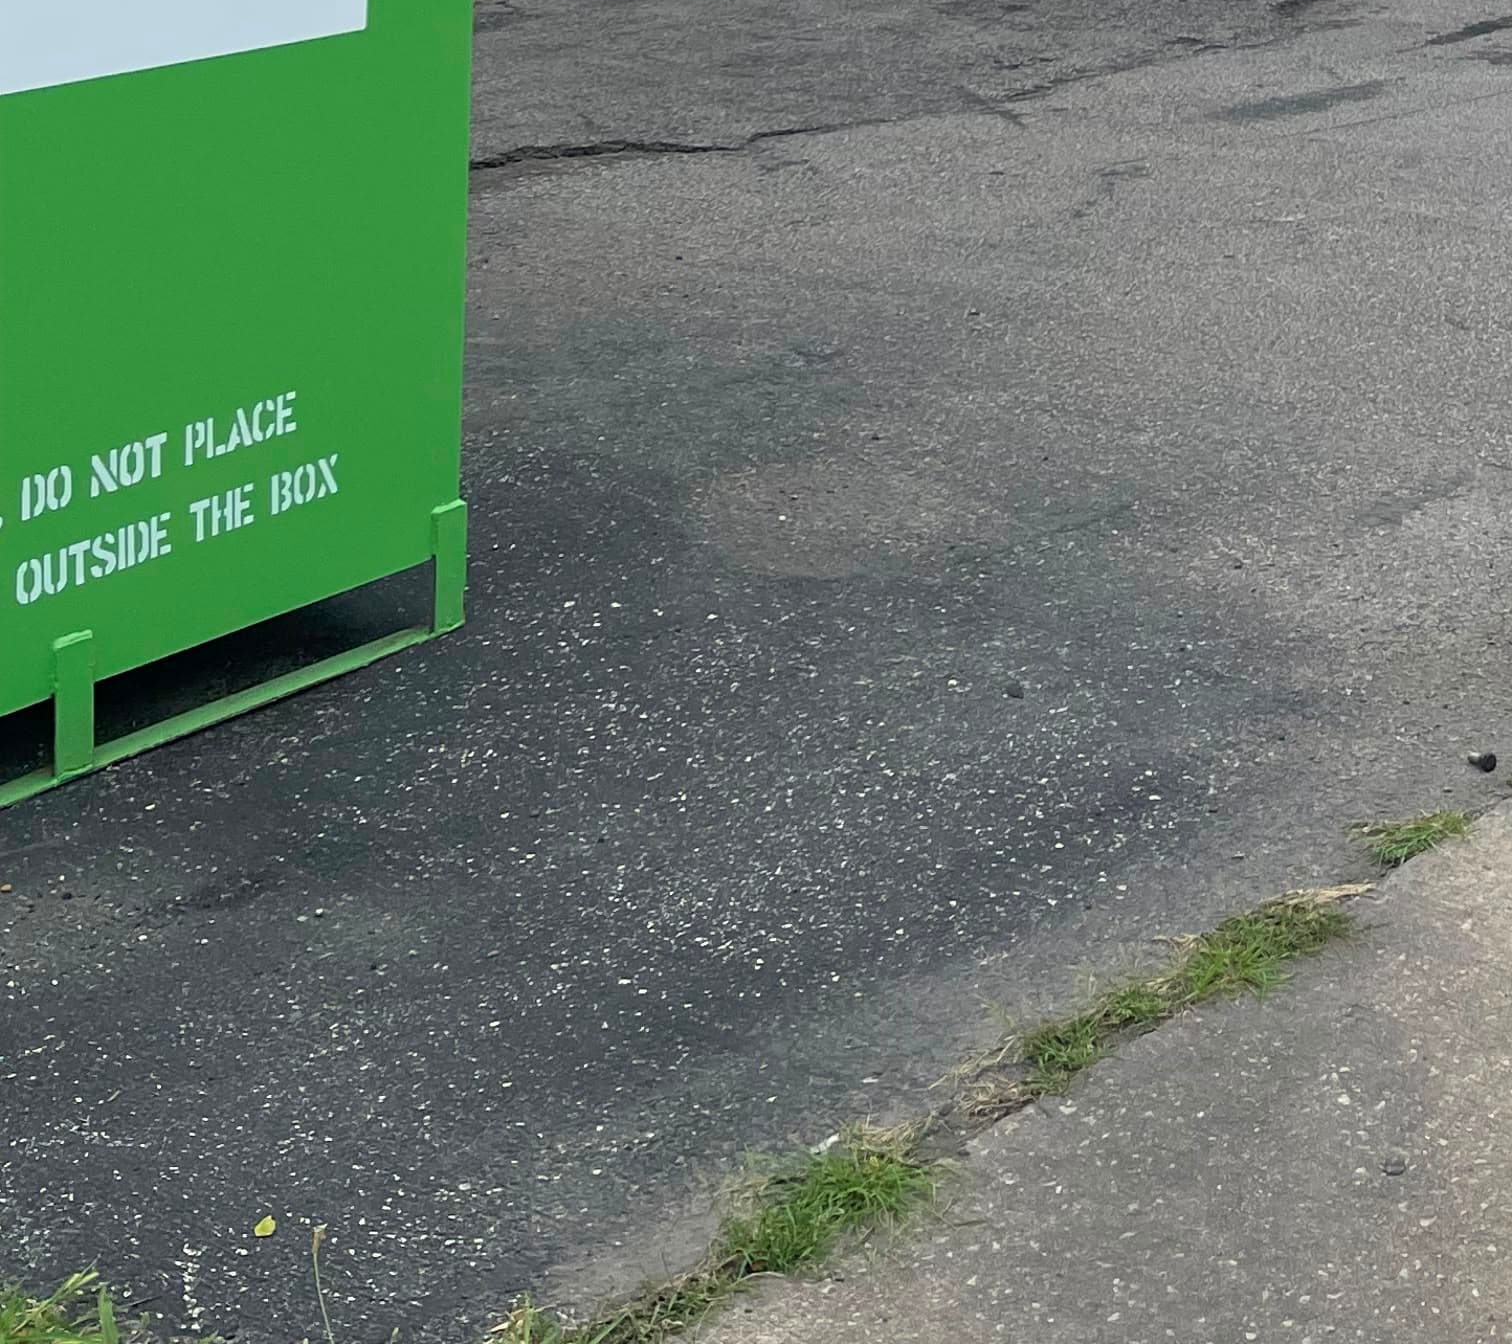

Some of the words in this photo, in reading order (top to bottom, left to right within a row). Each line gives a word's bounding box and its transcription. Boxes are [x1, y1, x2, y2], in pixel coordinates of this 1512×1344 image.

[20, 464, 73, 522] DO
[90, 432, 168, 499] NOT
[184, 390, 297, 467] PLACE
[16, 512, 172, 606] OUTSIDE
[189, 483, 255, 543] THE
[270, 454, 338, 516] BOX
